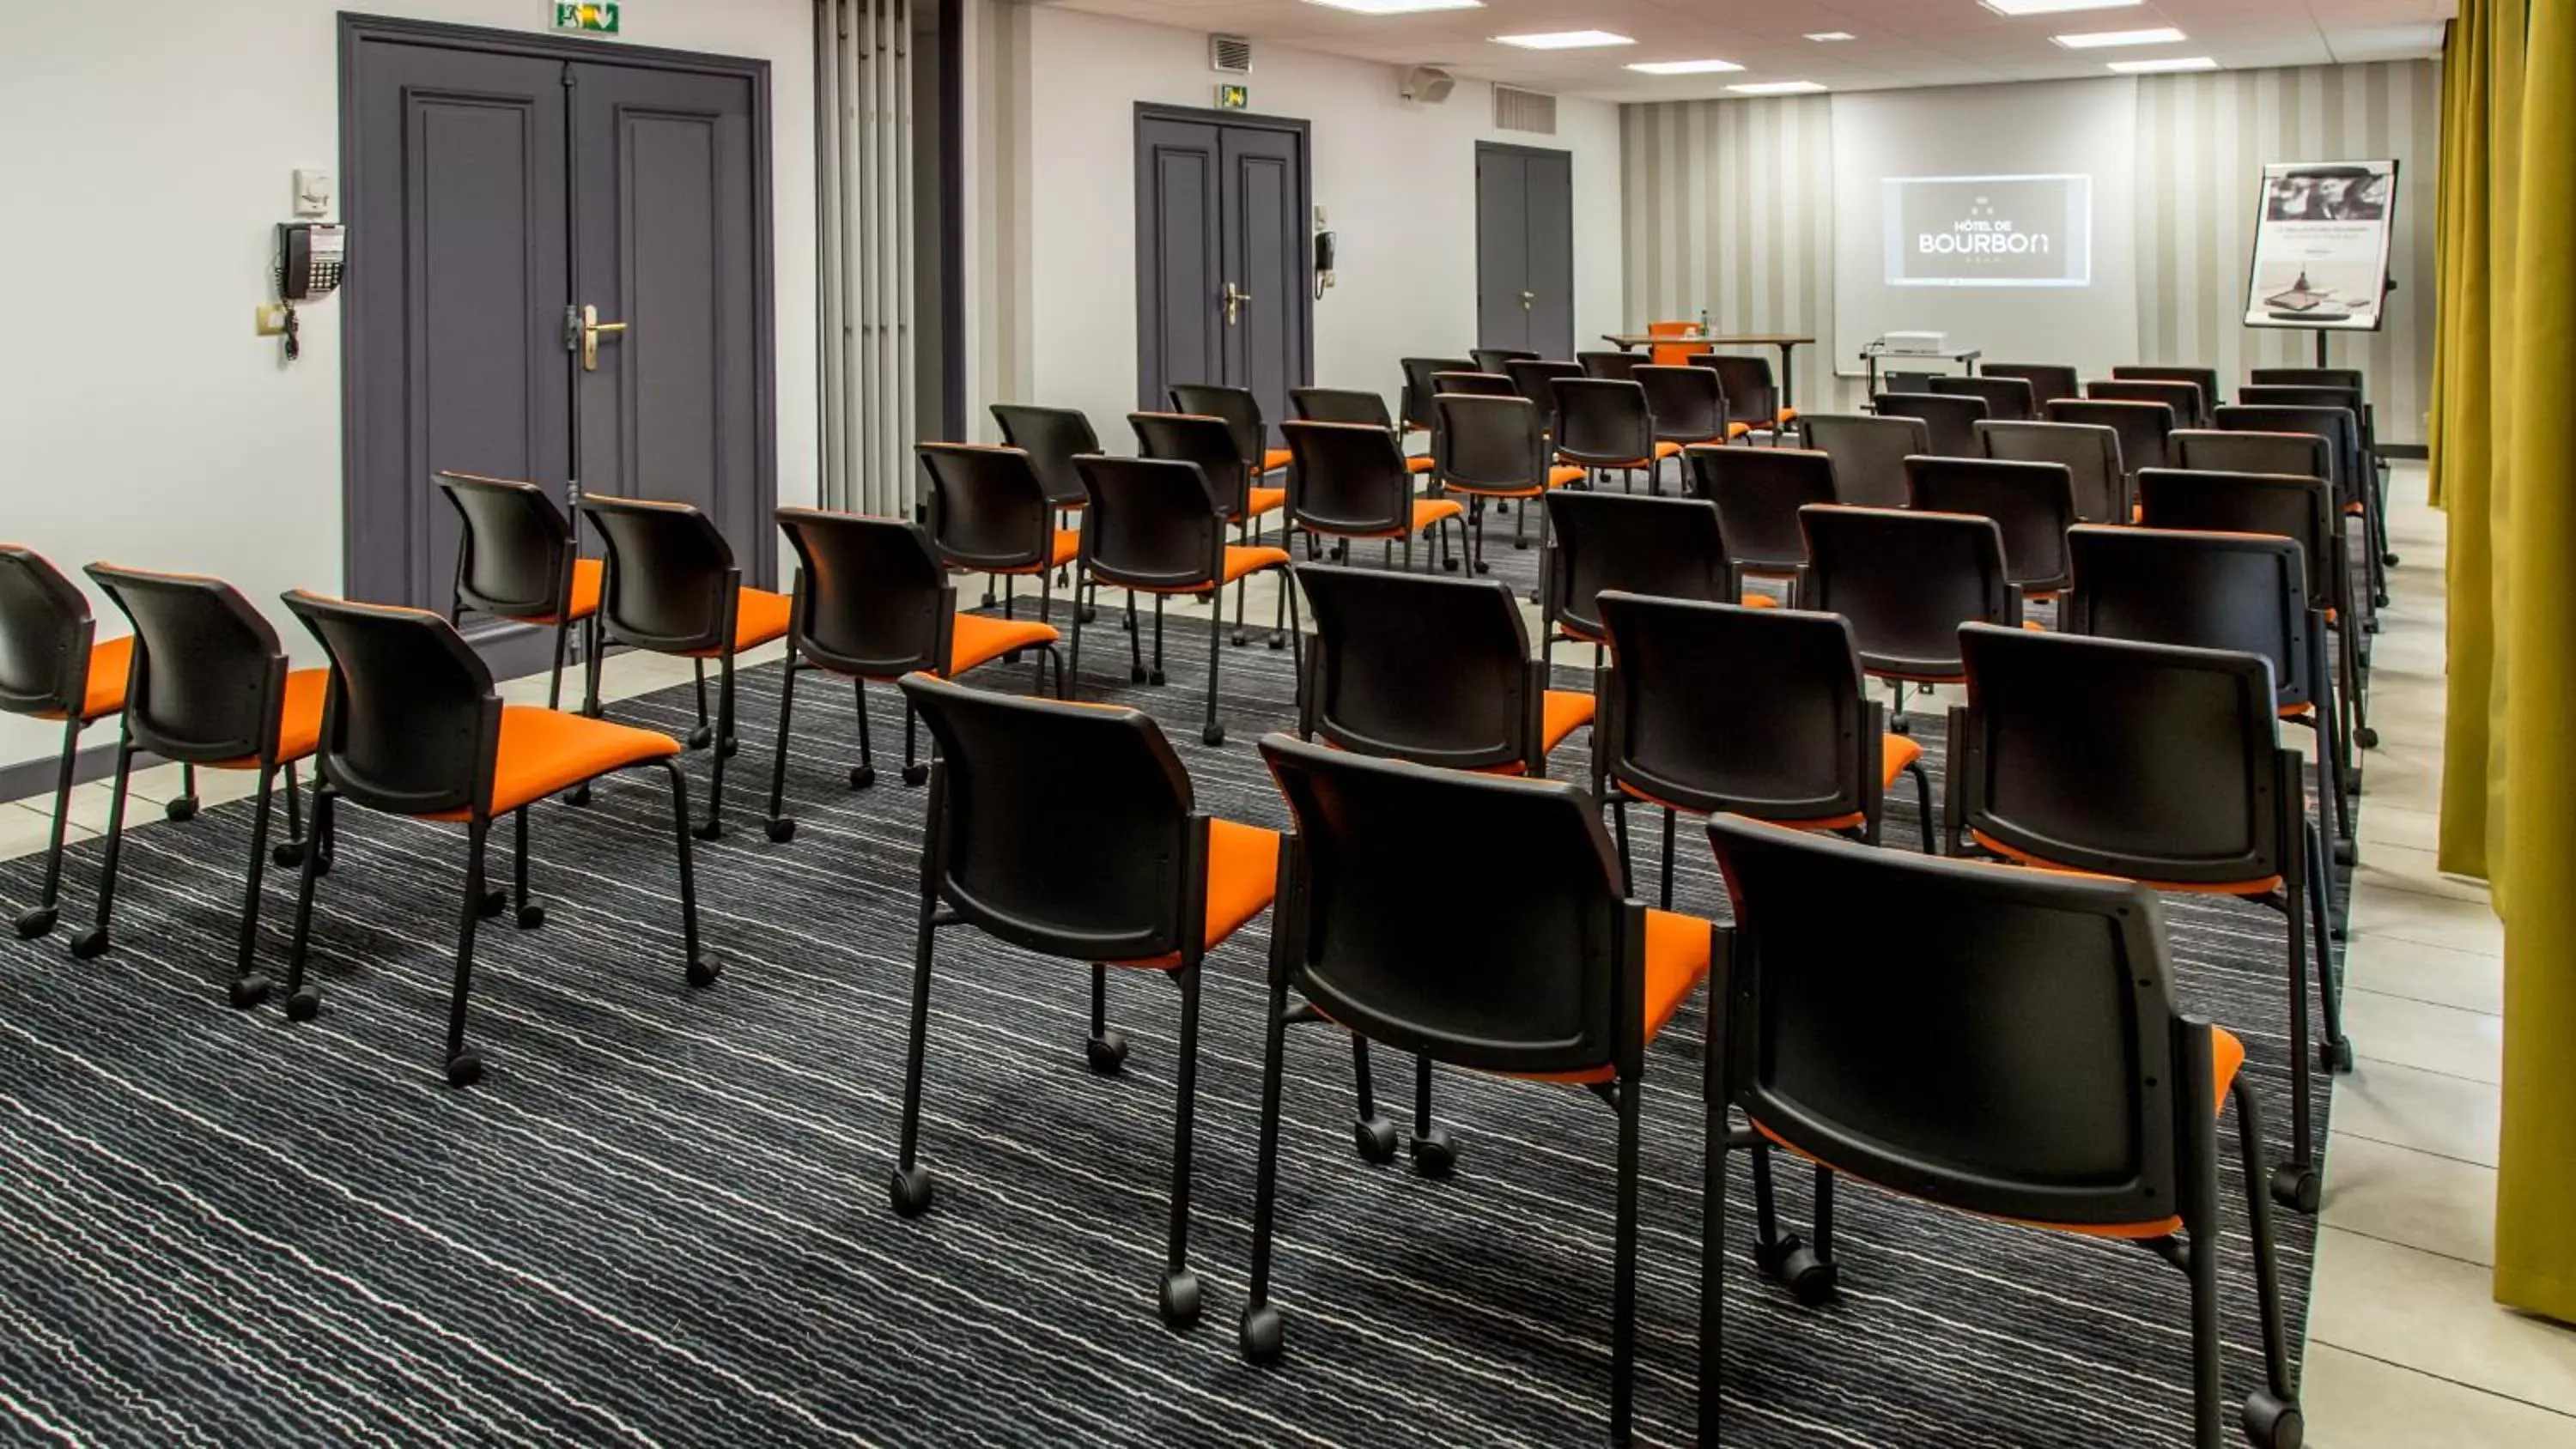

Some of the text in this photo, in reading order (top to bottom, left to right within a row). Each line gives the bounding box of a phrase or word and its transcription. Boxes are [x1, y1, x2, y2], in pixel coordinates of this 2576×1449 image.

[1954, 218, 2013, 232] HÔTEL DE
[1919, 233, 2049, 254] BOURBON
